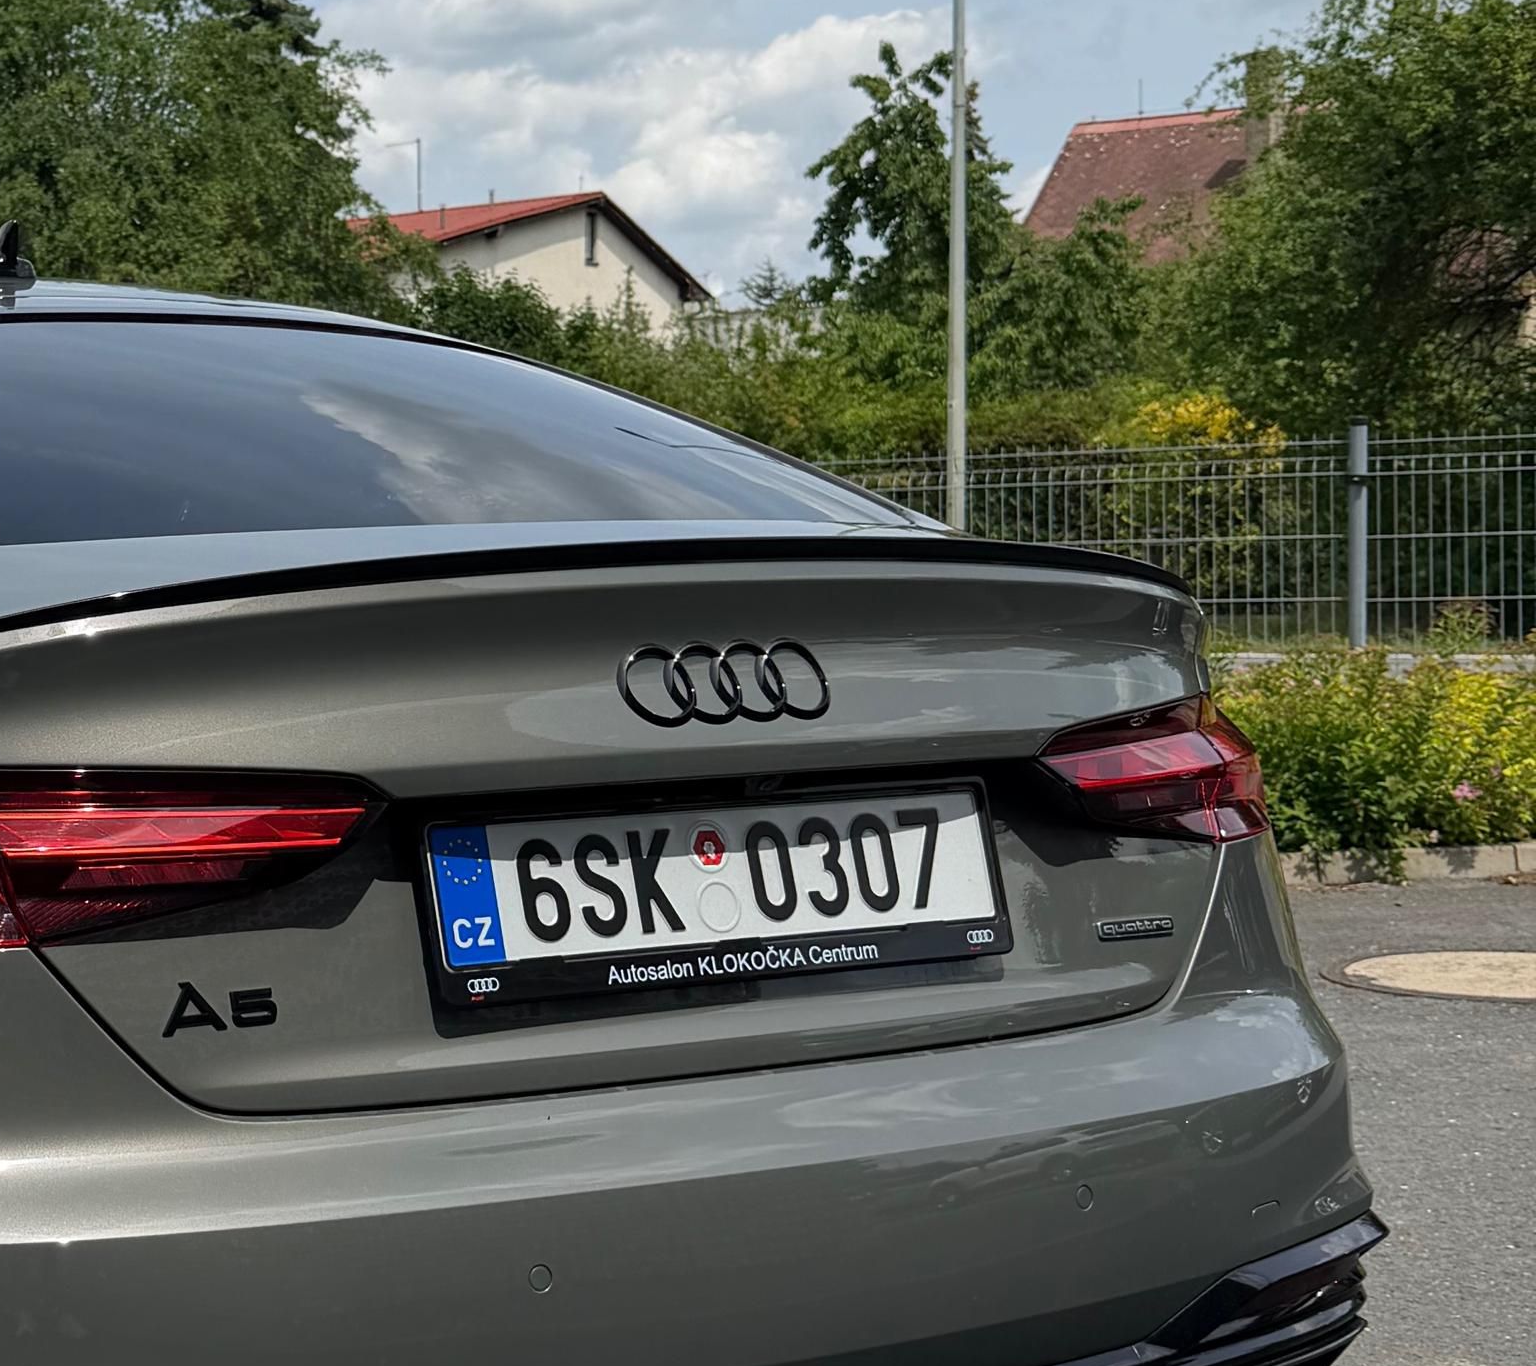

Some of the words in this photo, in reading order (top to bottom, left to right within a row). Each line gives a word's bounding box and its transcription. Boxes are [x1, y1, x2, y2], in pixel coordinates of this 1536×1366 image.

[516, 828, 687, 943] 6SK
[745, 807, 939, 922] 0307
[452, 916, 496, 948] CZ
[1103, 919, 1172, 935] quattro
[608, 959, 694, 985] Autosalon
[697, 945, 807, 976] KLOKOČKA
[808, 943, 879, 965] Centrum
[161, 981, 277, 1038] A5
